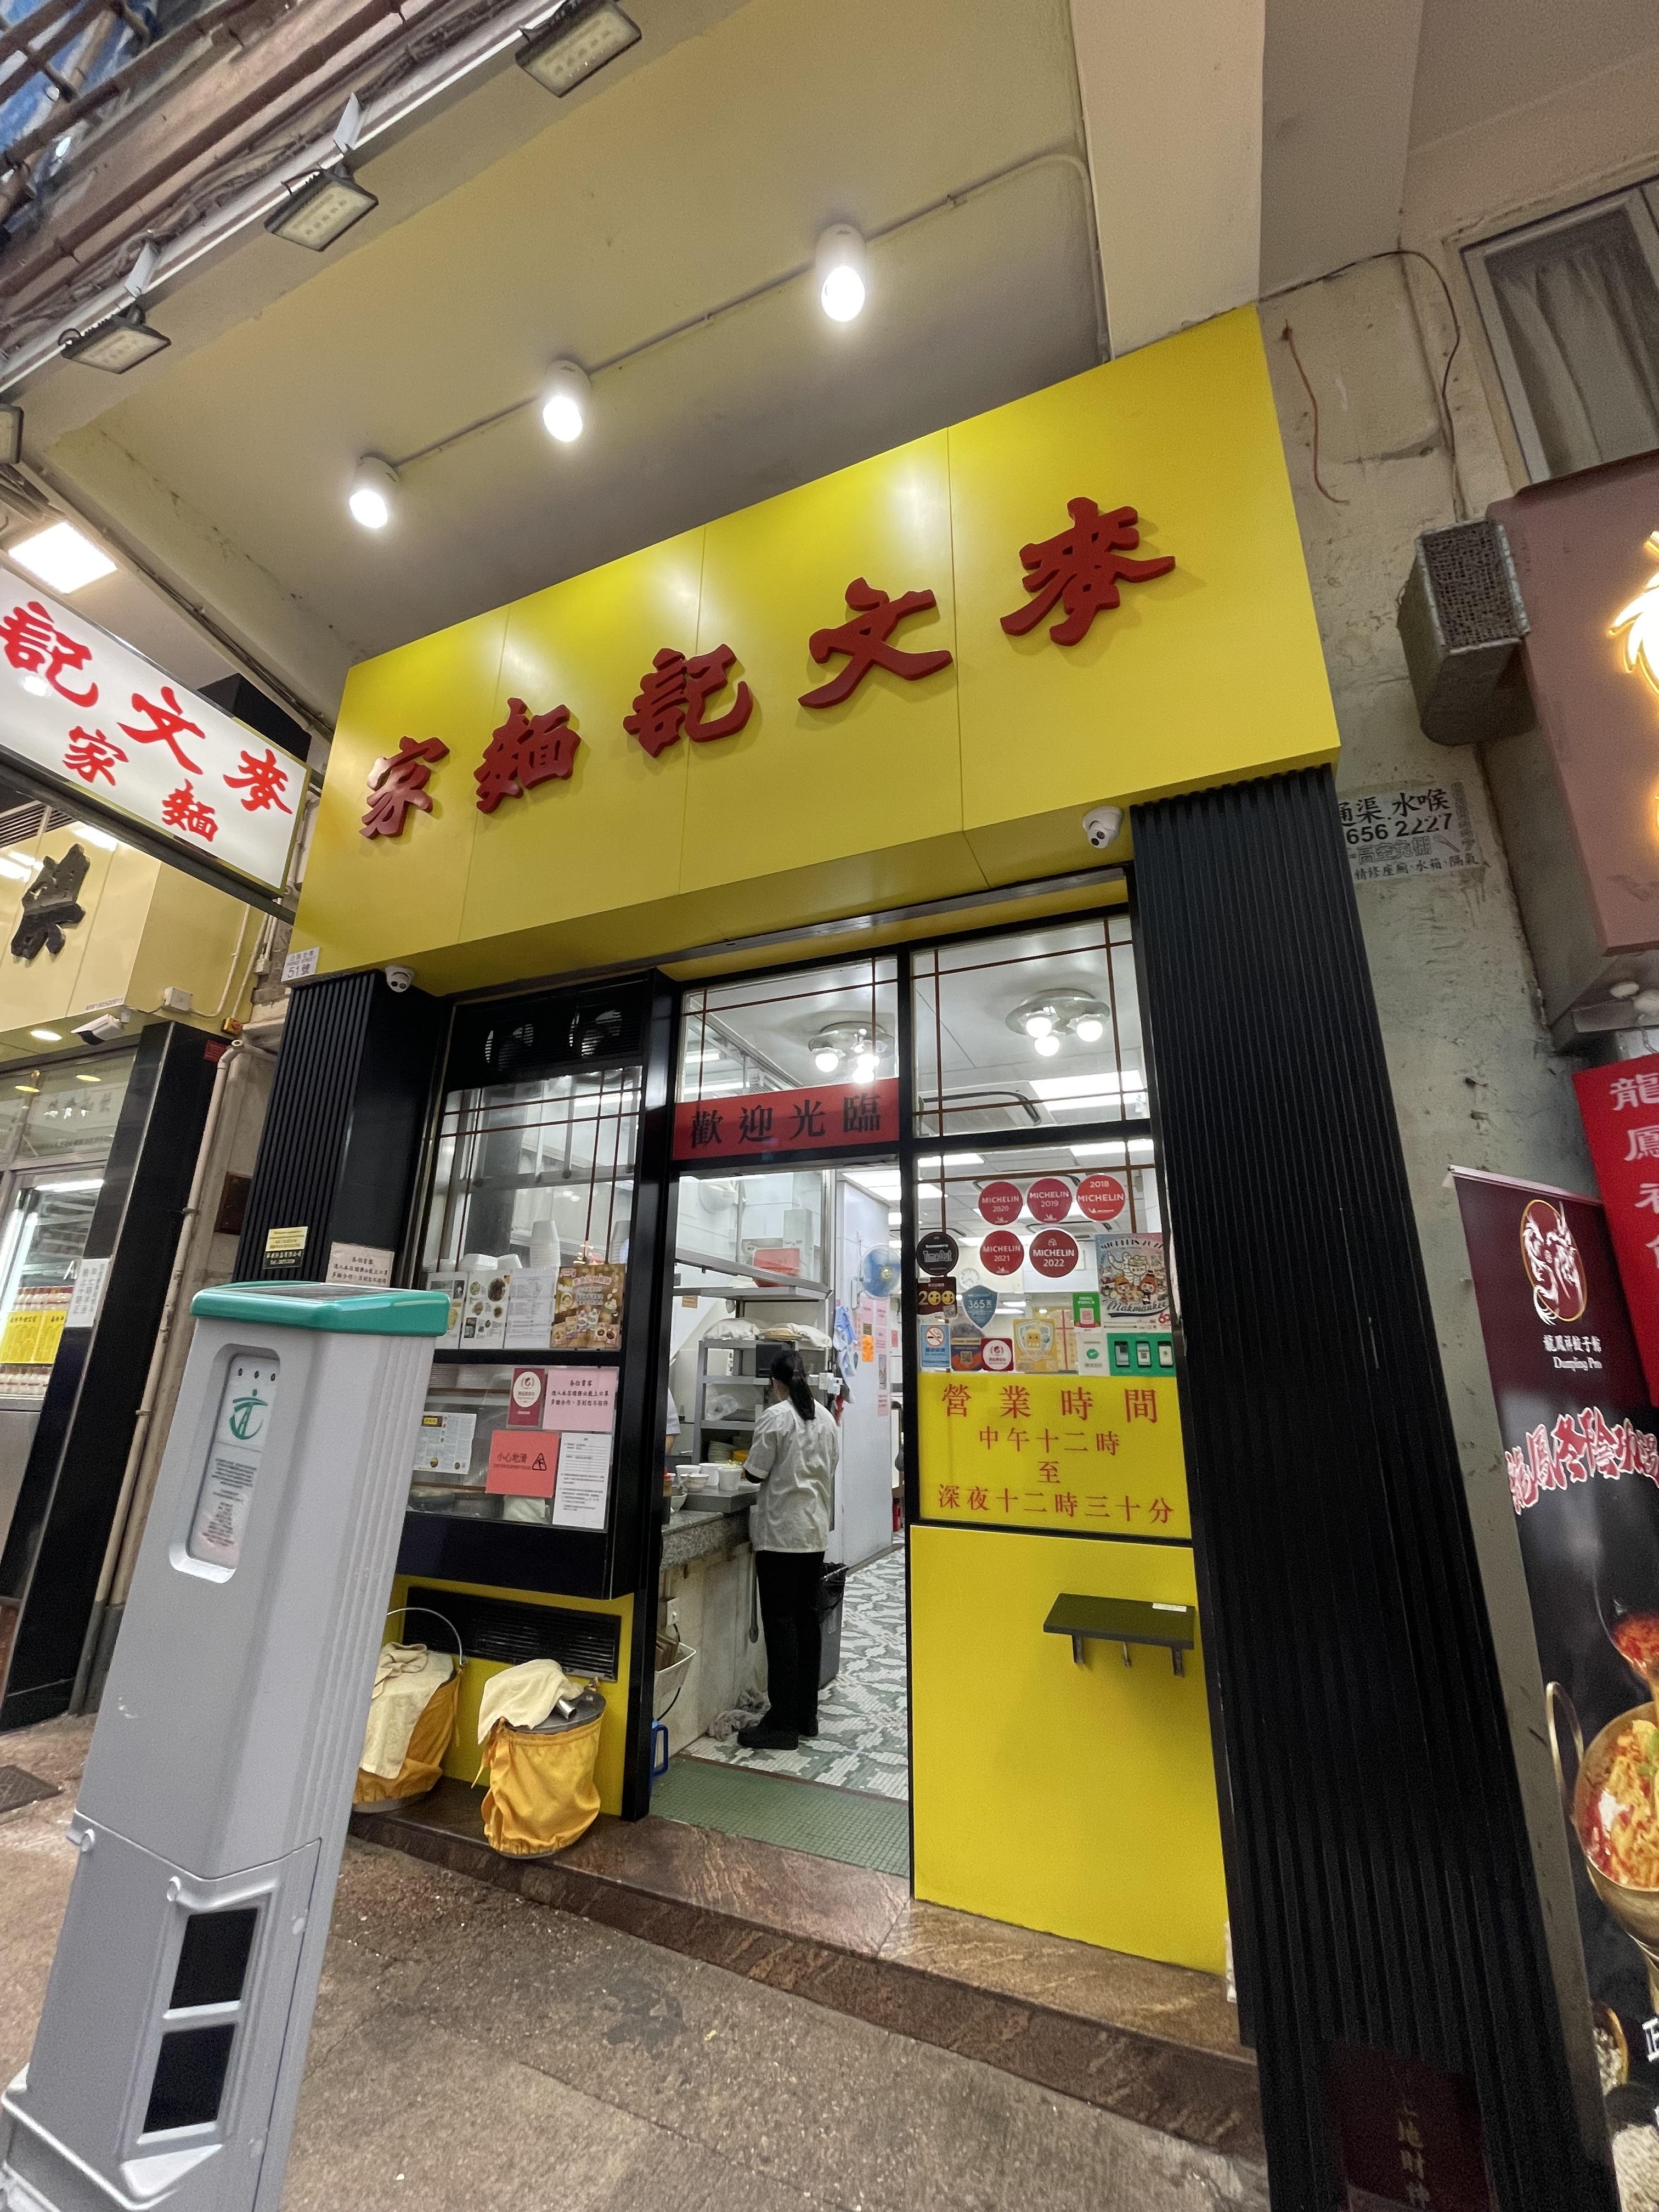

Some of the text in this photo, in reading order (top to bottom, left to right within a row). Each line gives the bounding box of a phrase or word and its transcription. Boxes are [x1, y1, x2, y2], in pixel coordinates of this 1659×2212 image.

[691, 1092, 881, 1149] 歡迎光臨
[1090, 1180, 1110, 1188] 2018
[981, 1195, 1020, 1204] MICHELIN
[1077, 1193, 1124, 1202] MICHELIN
[1032, 1249, 1075, 1257] MICHELIN
[1043, 1259, 1065, 1267] 2022
[941, 1383, 1158, 1424] 營業時間
[979, 1425, 1120, 1457] 中午十二時
[1037, 1460, 1061, 1485] 至
[938, 1483, 1174, 1525] 深夜十二時三十分
